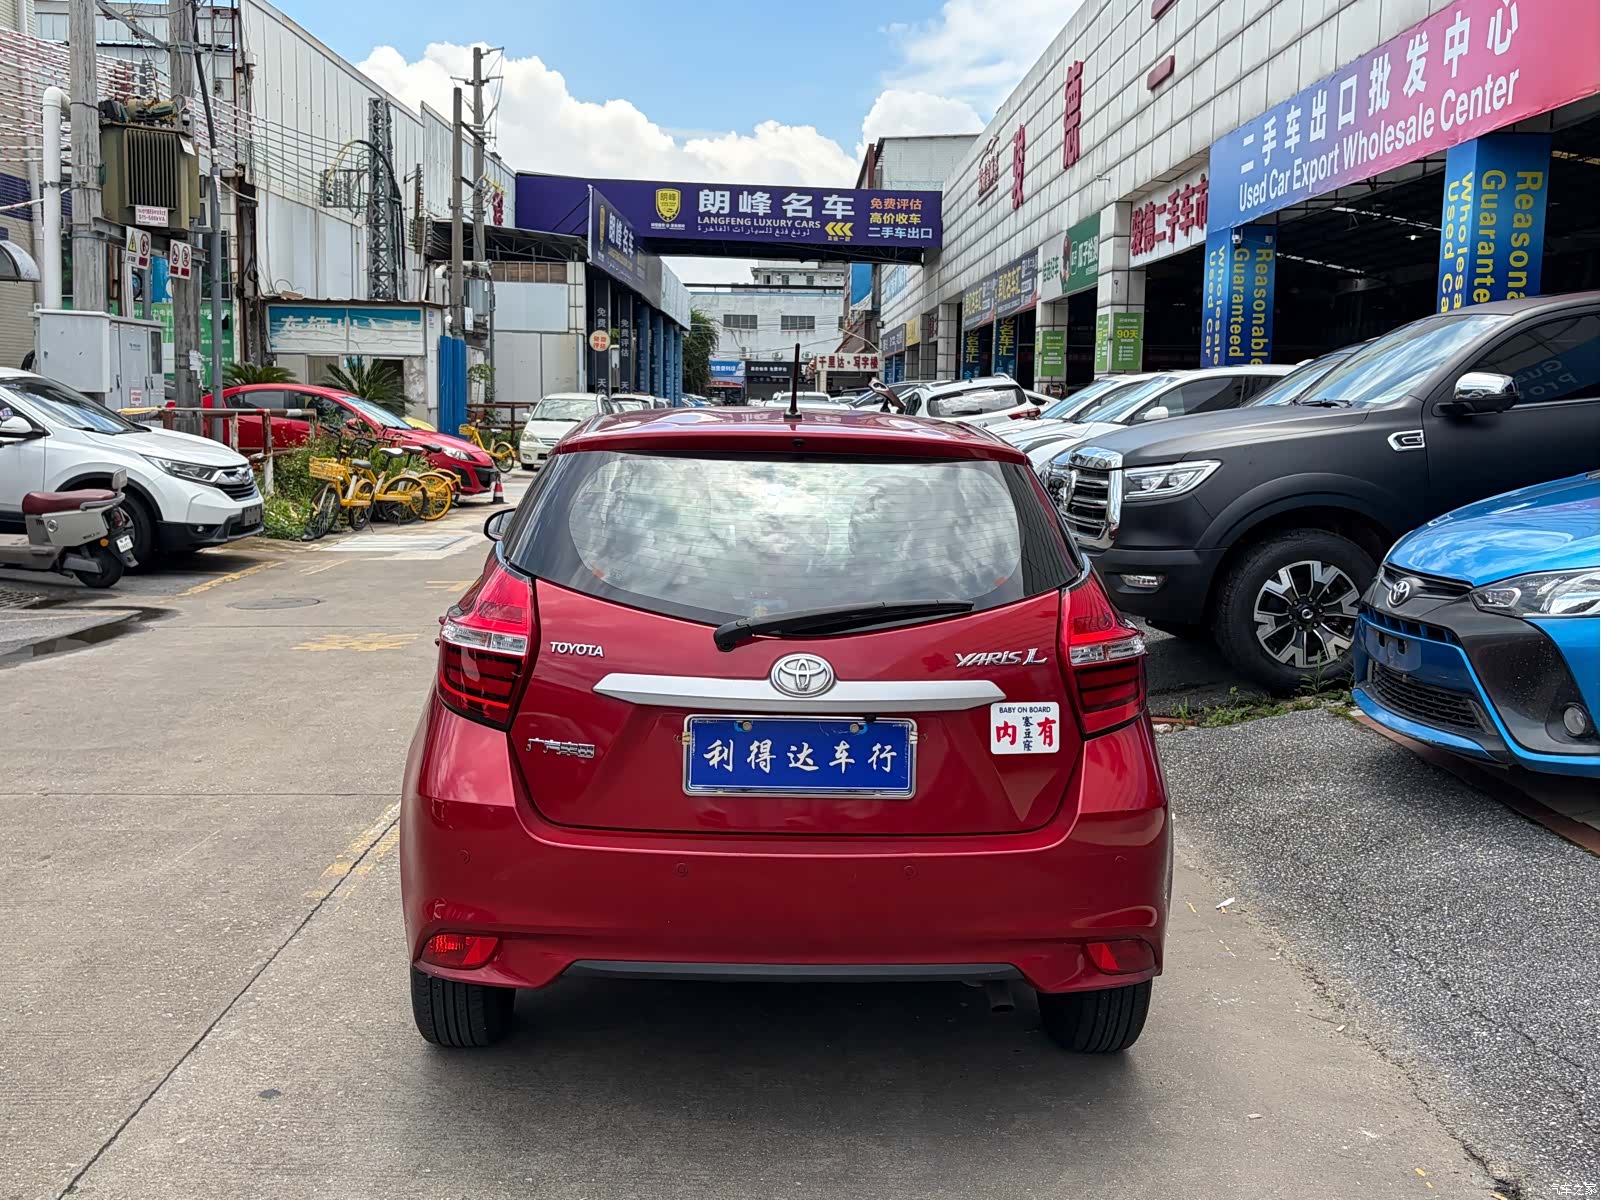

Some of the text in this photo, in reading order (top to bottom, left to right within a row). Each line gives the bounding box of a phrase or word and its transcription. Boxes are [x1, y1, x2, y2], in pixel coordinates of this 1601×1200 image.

[1241, 0, 1519, 174] 二手车出口批发中心
[1240, 68, 1520, 212] Used Car Export Wholesale Center
[698, 189, 855, 219] 朗峰名车
[869, 212, 921, 225] 高价收车
[870, 197, 922, 210] 免费评估
[697, 216, 821, 229] LANGFENG LUXURY CARS
[867, 227, 933, 240] 二手车出口
[1443, 180, 1460, 260] Used
[1205, 251, 1217, 357] Used Car
[1213, 244, 1226, 365] Wholesale
[1228, 247, 1251, 358] Guaranteed
[1250, 248, 1275, 366] Reasonable
[1117, 329, 1138, 338] 90天
[550, 641, 604, 657] TOYOTA
[955, 651, 1022, 667] YARIS
[996, 720, 1017, 746] 内
[1037, 717, 1056, 747] 有
[703, 739, 897, 774] 利得达车行
